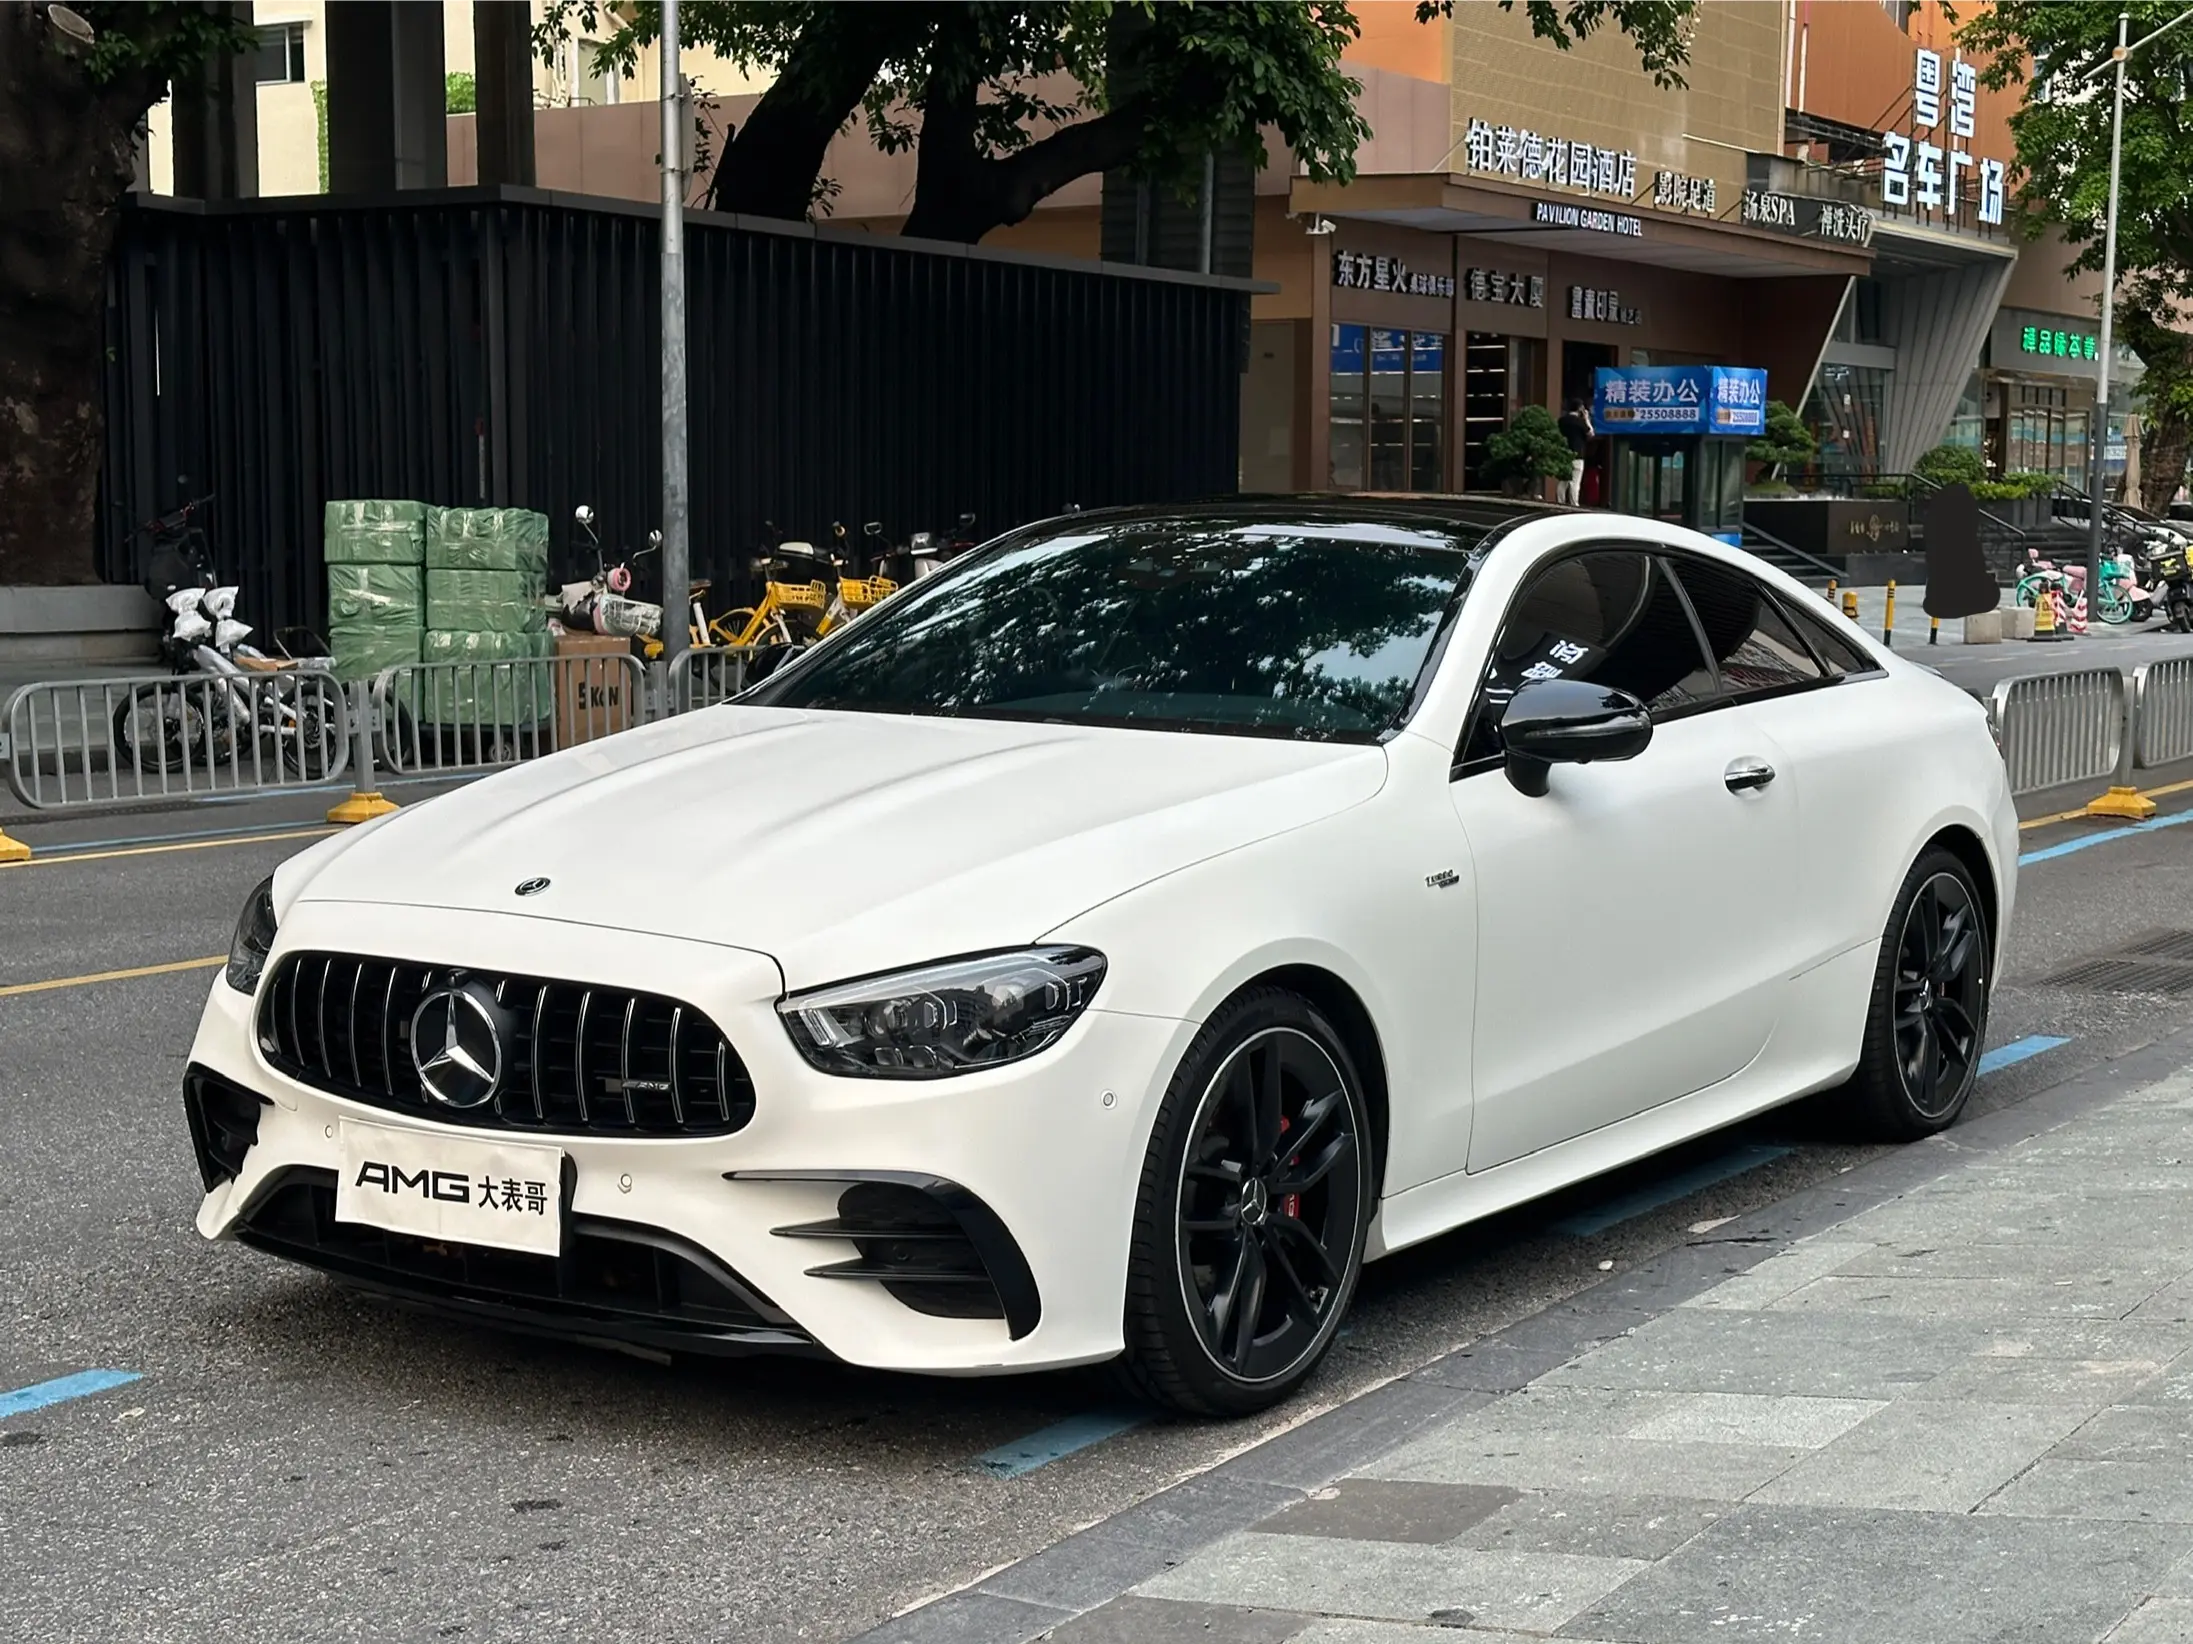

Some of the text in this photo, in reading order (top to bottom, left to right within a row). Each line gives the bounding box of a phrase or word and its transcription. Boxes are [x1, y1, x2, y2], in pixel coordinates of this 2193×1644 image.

[1915, 48, 1976, 138] 粤湾
[1464, 117, 1637, 198] 铂莱德花园酒店
[1884, 131, 2004, 225] 名车广场
[1654, 171, 1716, 213] 影院足道
[1536, 202, 1643, 237] PAVILION GARDEN HOTEL
[1337, 250, 1408, 293] 东方星火
[1470, 268, 1545, 309] 德宝大厦
[1604, 378, 1700, 403] 精装办公
[1717, 377, 1761, 405] 精装办公
[1639, 408, 1698, 420] 25508888
[354, 1160, 549, 1216] AMG 大表哥
